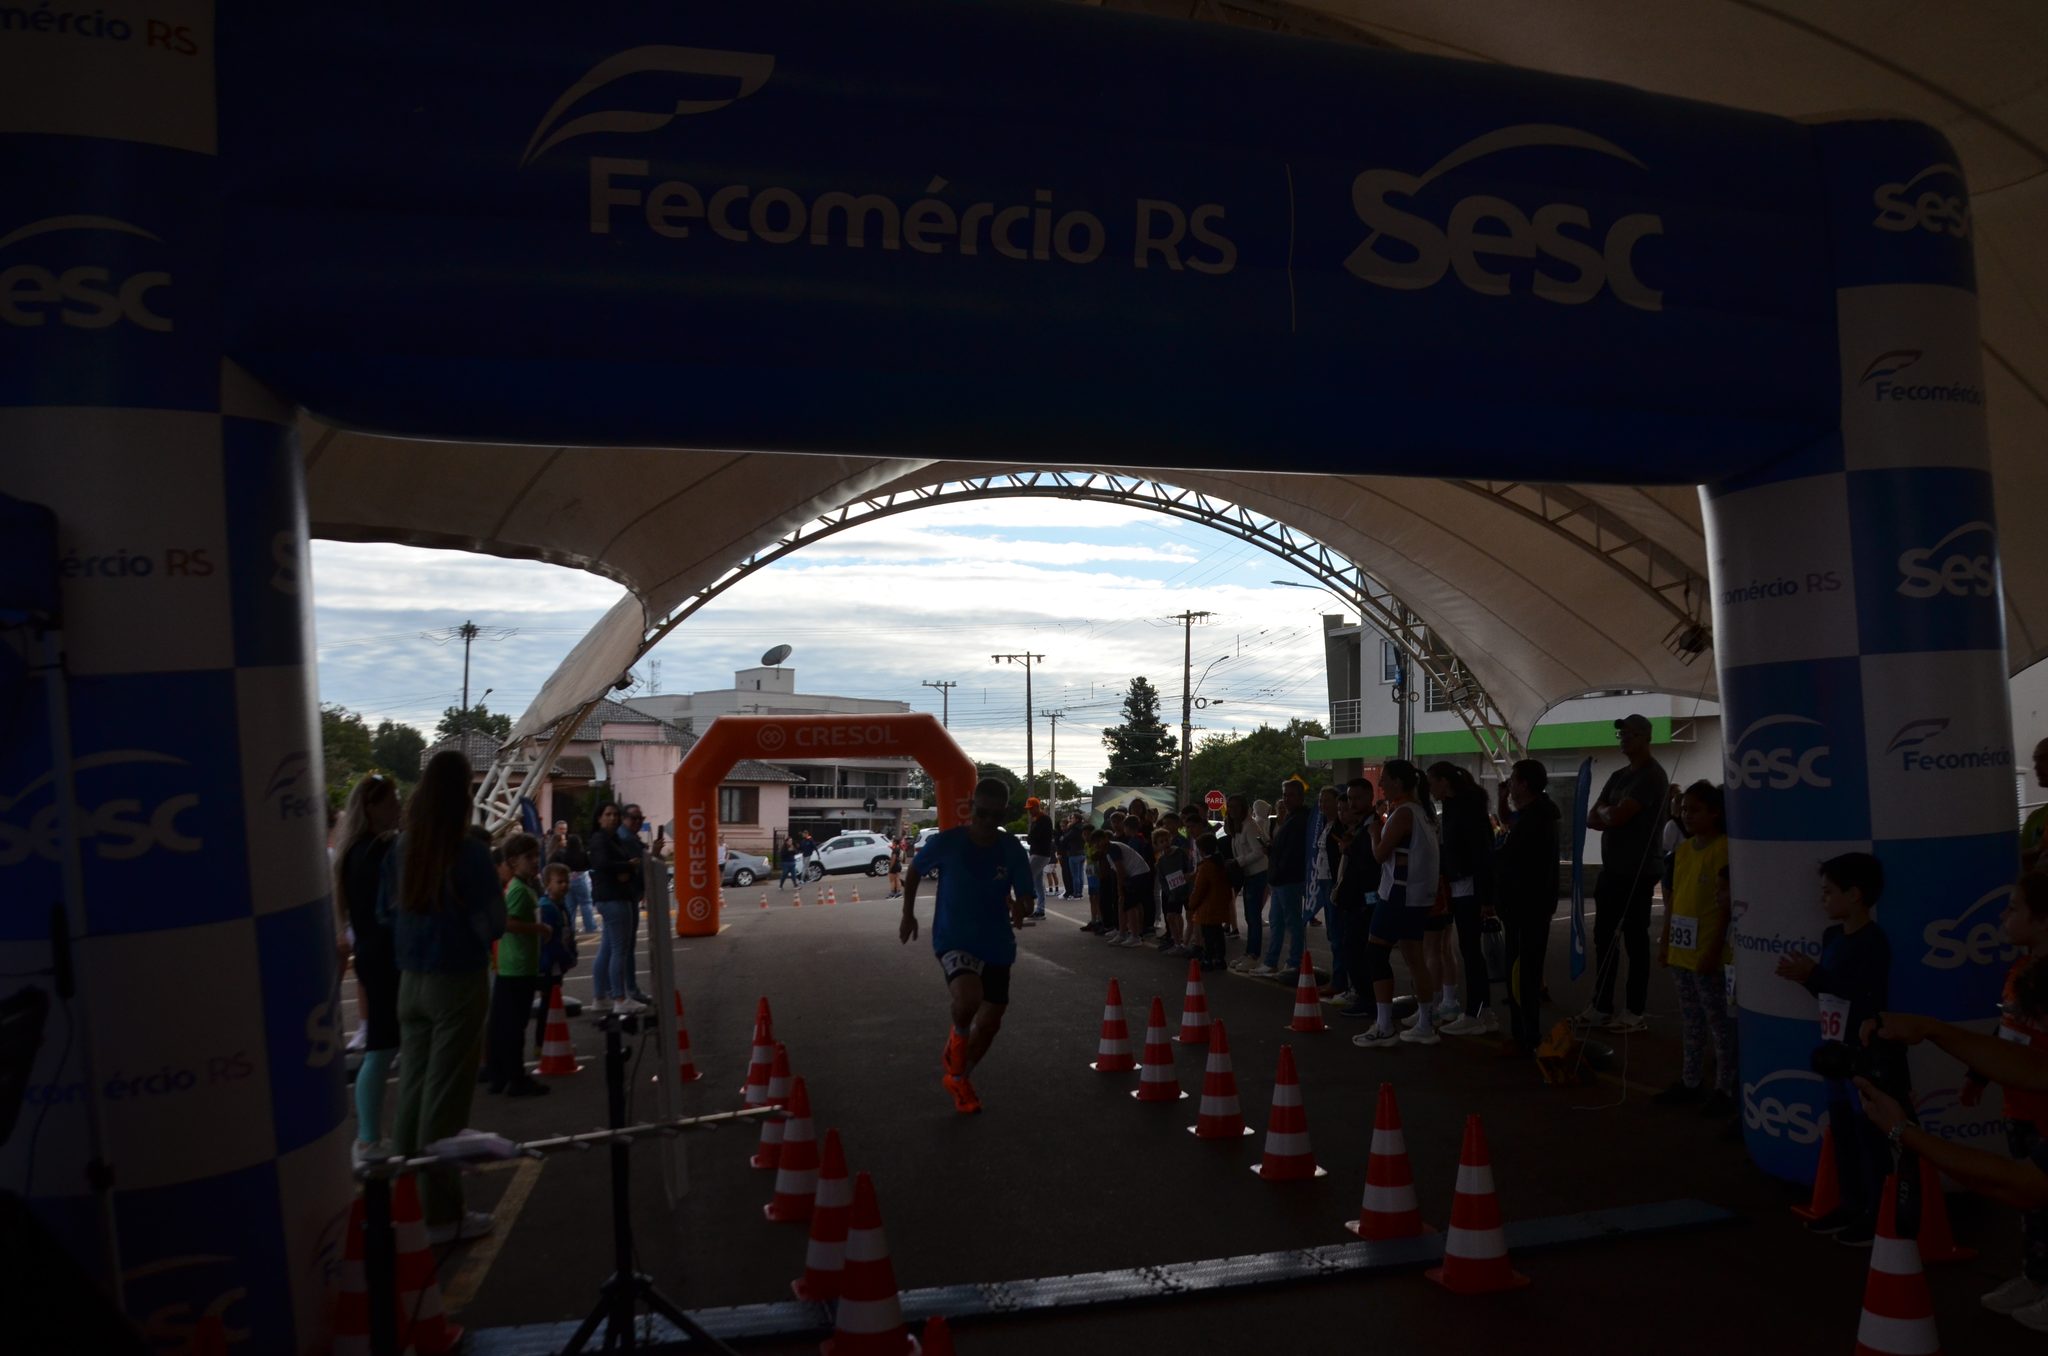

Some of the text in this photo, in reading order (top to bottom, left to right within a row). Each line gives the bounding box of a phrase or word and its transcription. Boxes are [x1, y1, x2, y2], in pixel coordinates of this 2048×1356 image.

[147, 18, 197, 55] RS
[589, 157, 1238, 275] Fecomércio RS
[1343, 168, 1664, 312] Sesc
[166, 549, 215, 577] RS
[1806, 572, 1842, 593] RS
[795, 725, 899, 747] CRESOL
[688, 800, 707, 889] CRESOL
[208, 1052, 254, 1084] RS
